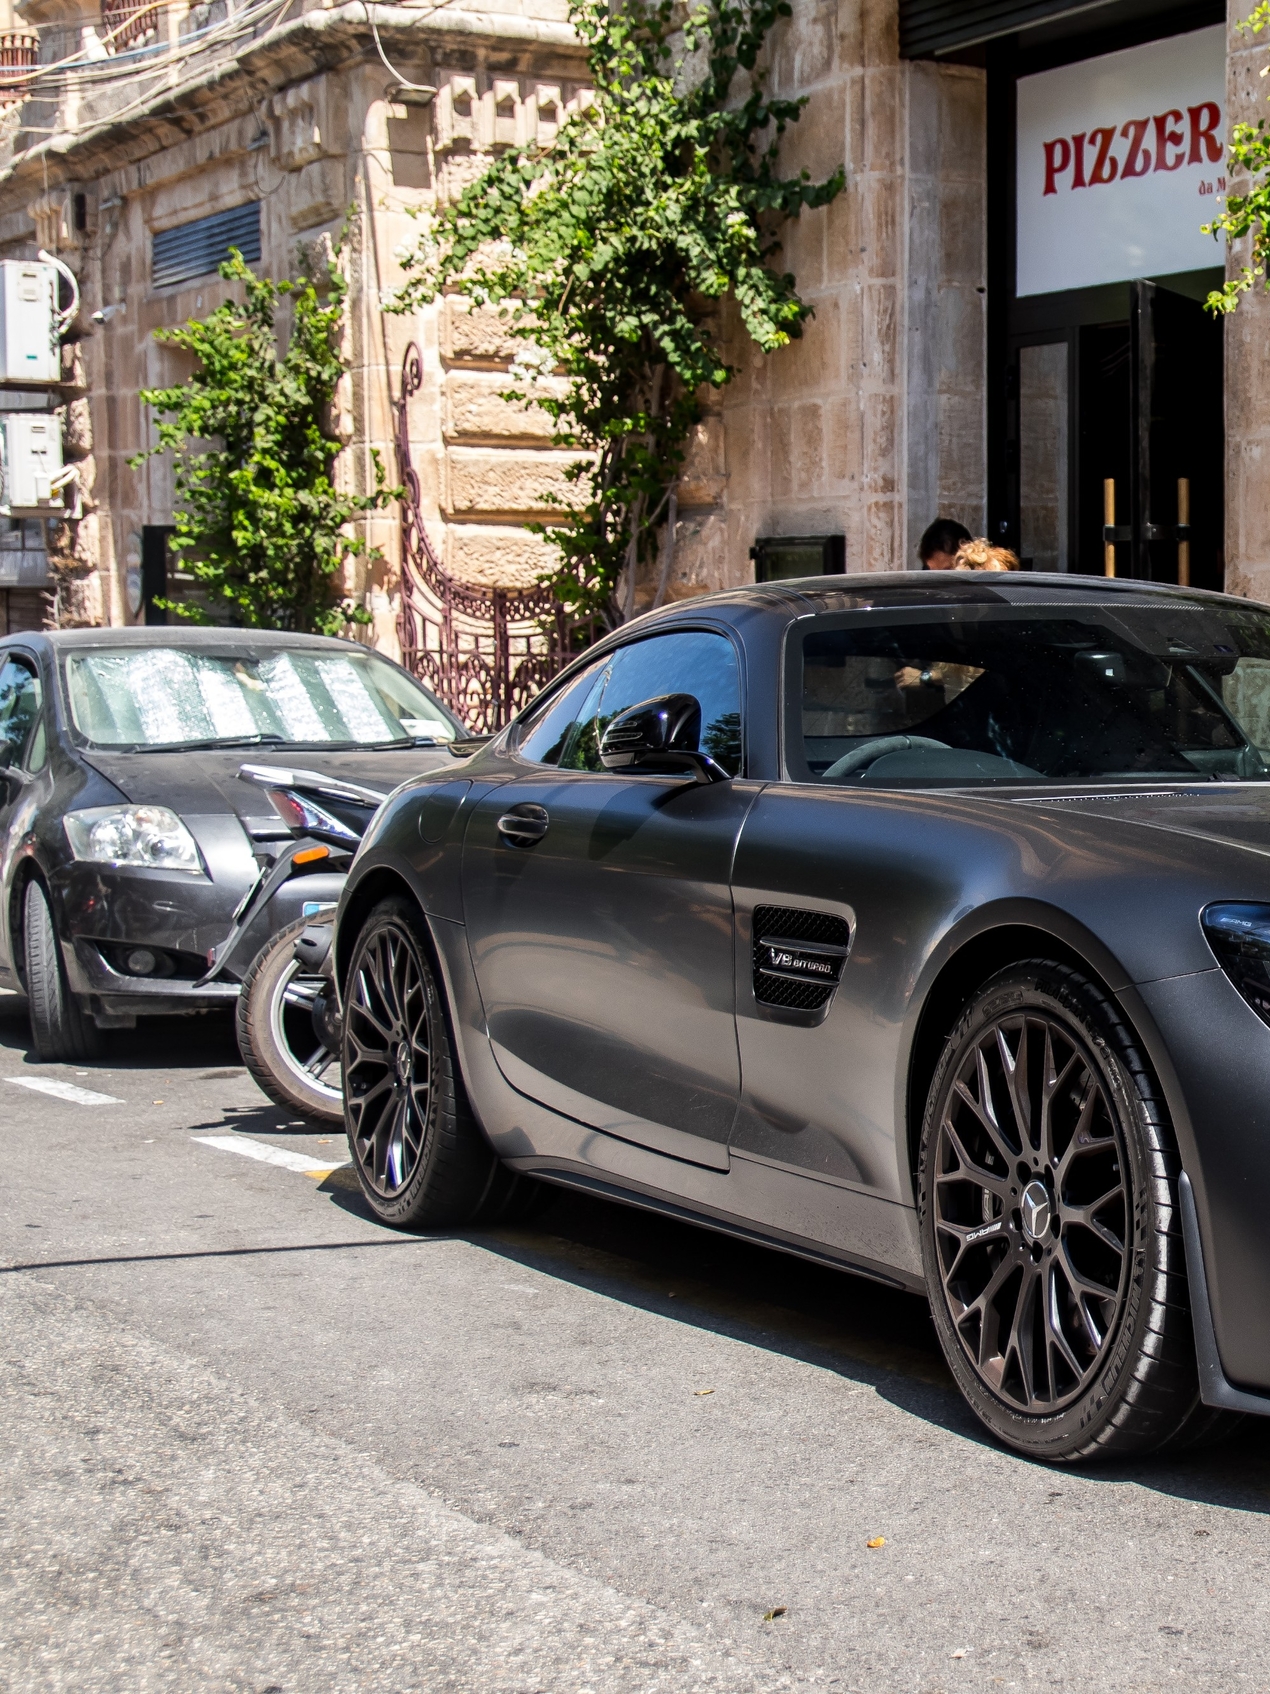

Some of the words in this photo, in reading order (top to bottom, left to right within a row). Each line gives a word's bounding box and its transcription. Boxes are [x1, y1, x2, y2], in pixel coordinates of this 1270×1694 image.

[1199, 180, 1213, 196] da
[770, 948, 792, 966] V8
[1103, 1281, 1143, 1394] MICHELIN
